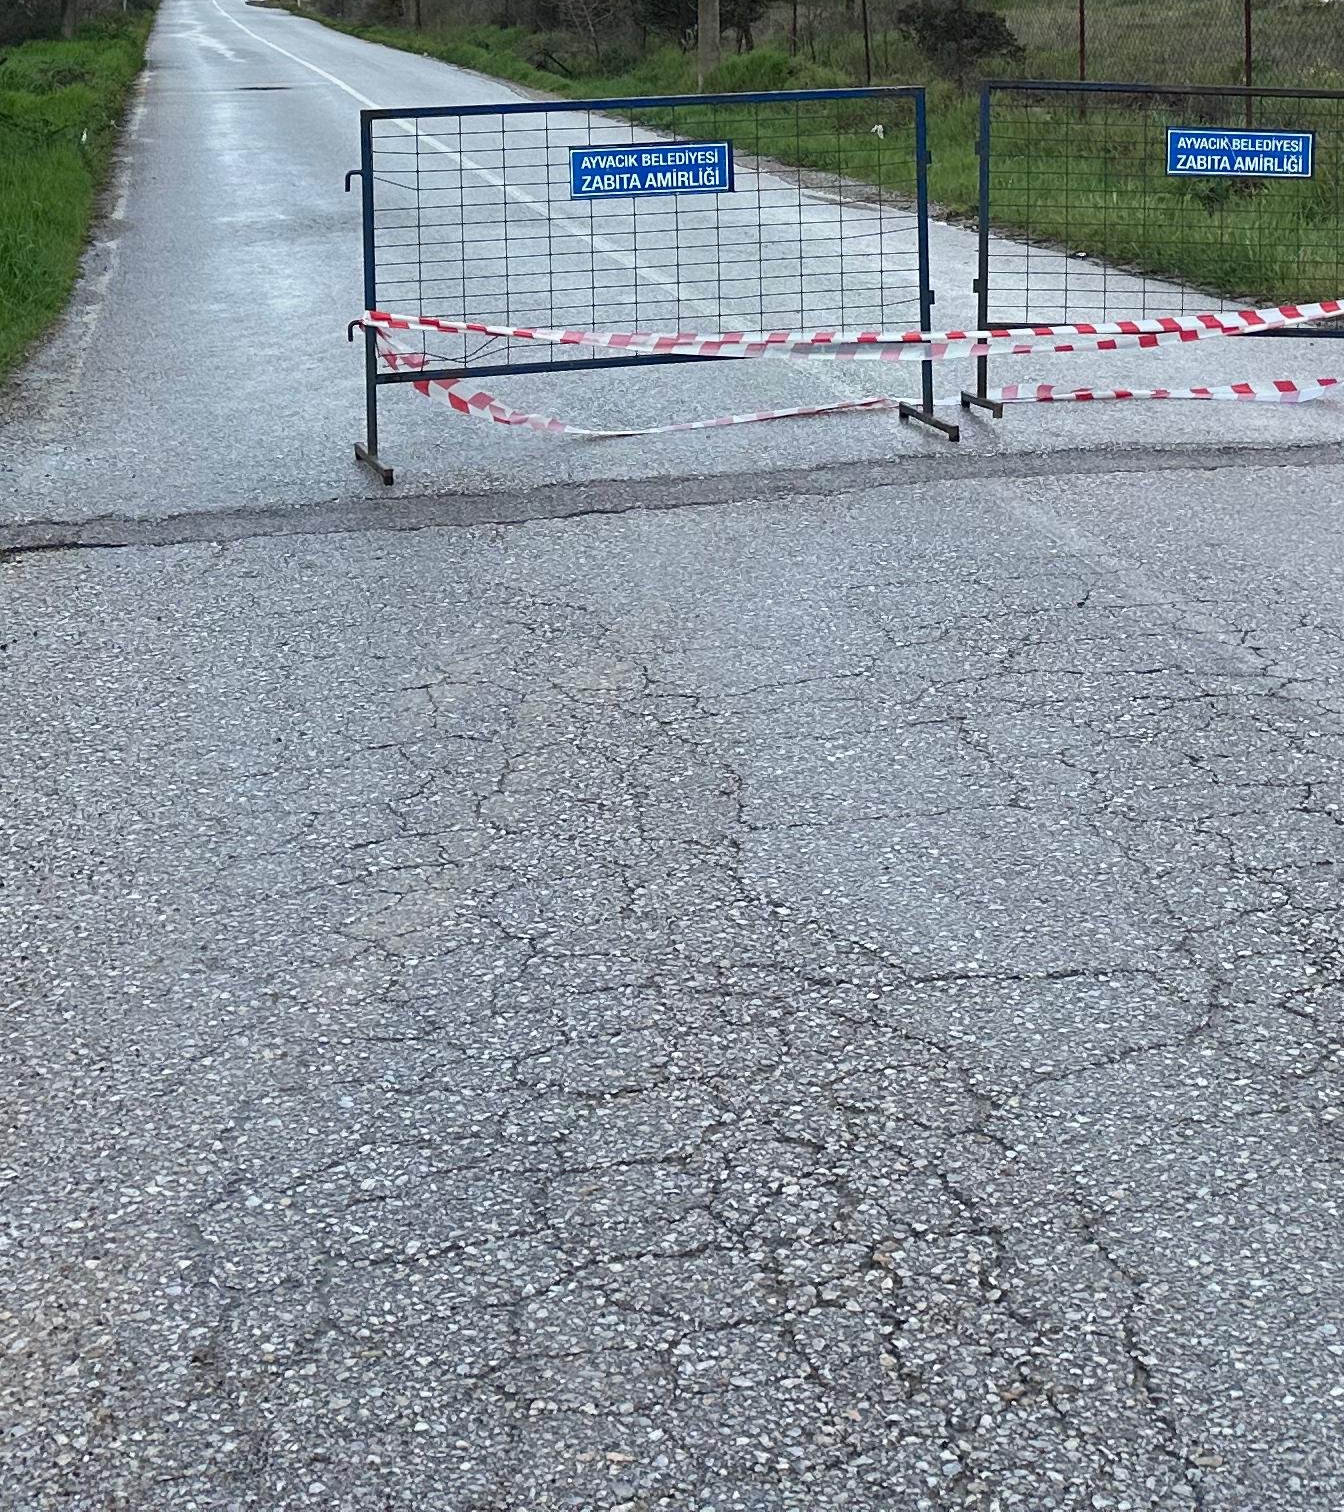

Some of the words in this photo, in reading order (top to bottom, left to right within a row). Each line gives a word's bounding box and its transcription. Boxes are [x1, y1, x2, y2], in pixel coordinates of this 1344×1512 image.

[1177, 136, 1229, 151] AYVACIK
[1231, 136, 1304, 153] BELEDİYESİ
[581, 154, 638, 170] AYVACIK
[641, 148, 719, 167] BELEDİYESİ
[1176, 155, 1231, 170] ZABITA
[1233, 153, 1304, 173] AMİRLİĞİ
[581, 173, 642, 192] ZABITA
[644, 166, 720, 190] AMİRLİĞİ
